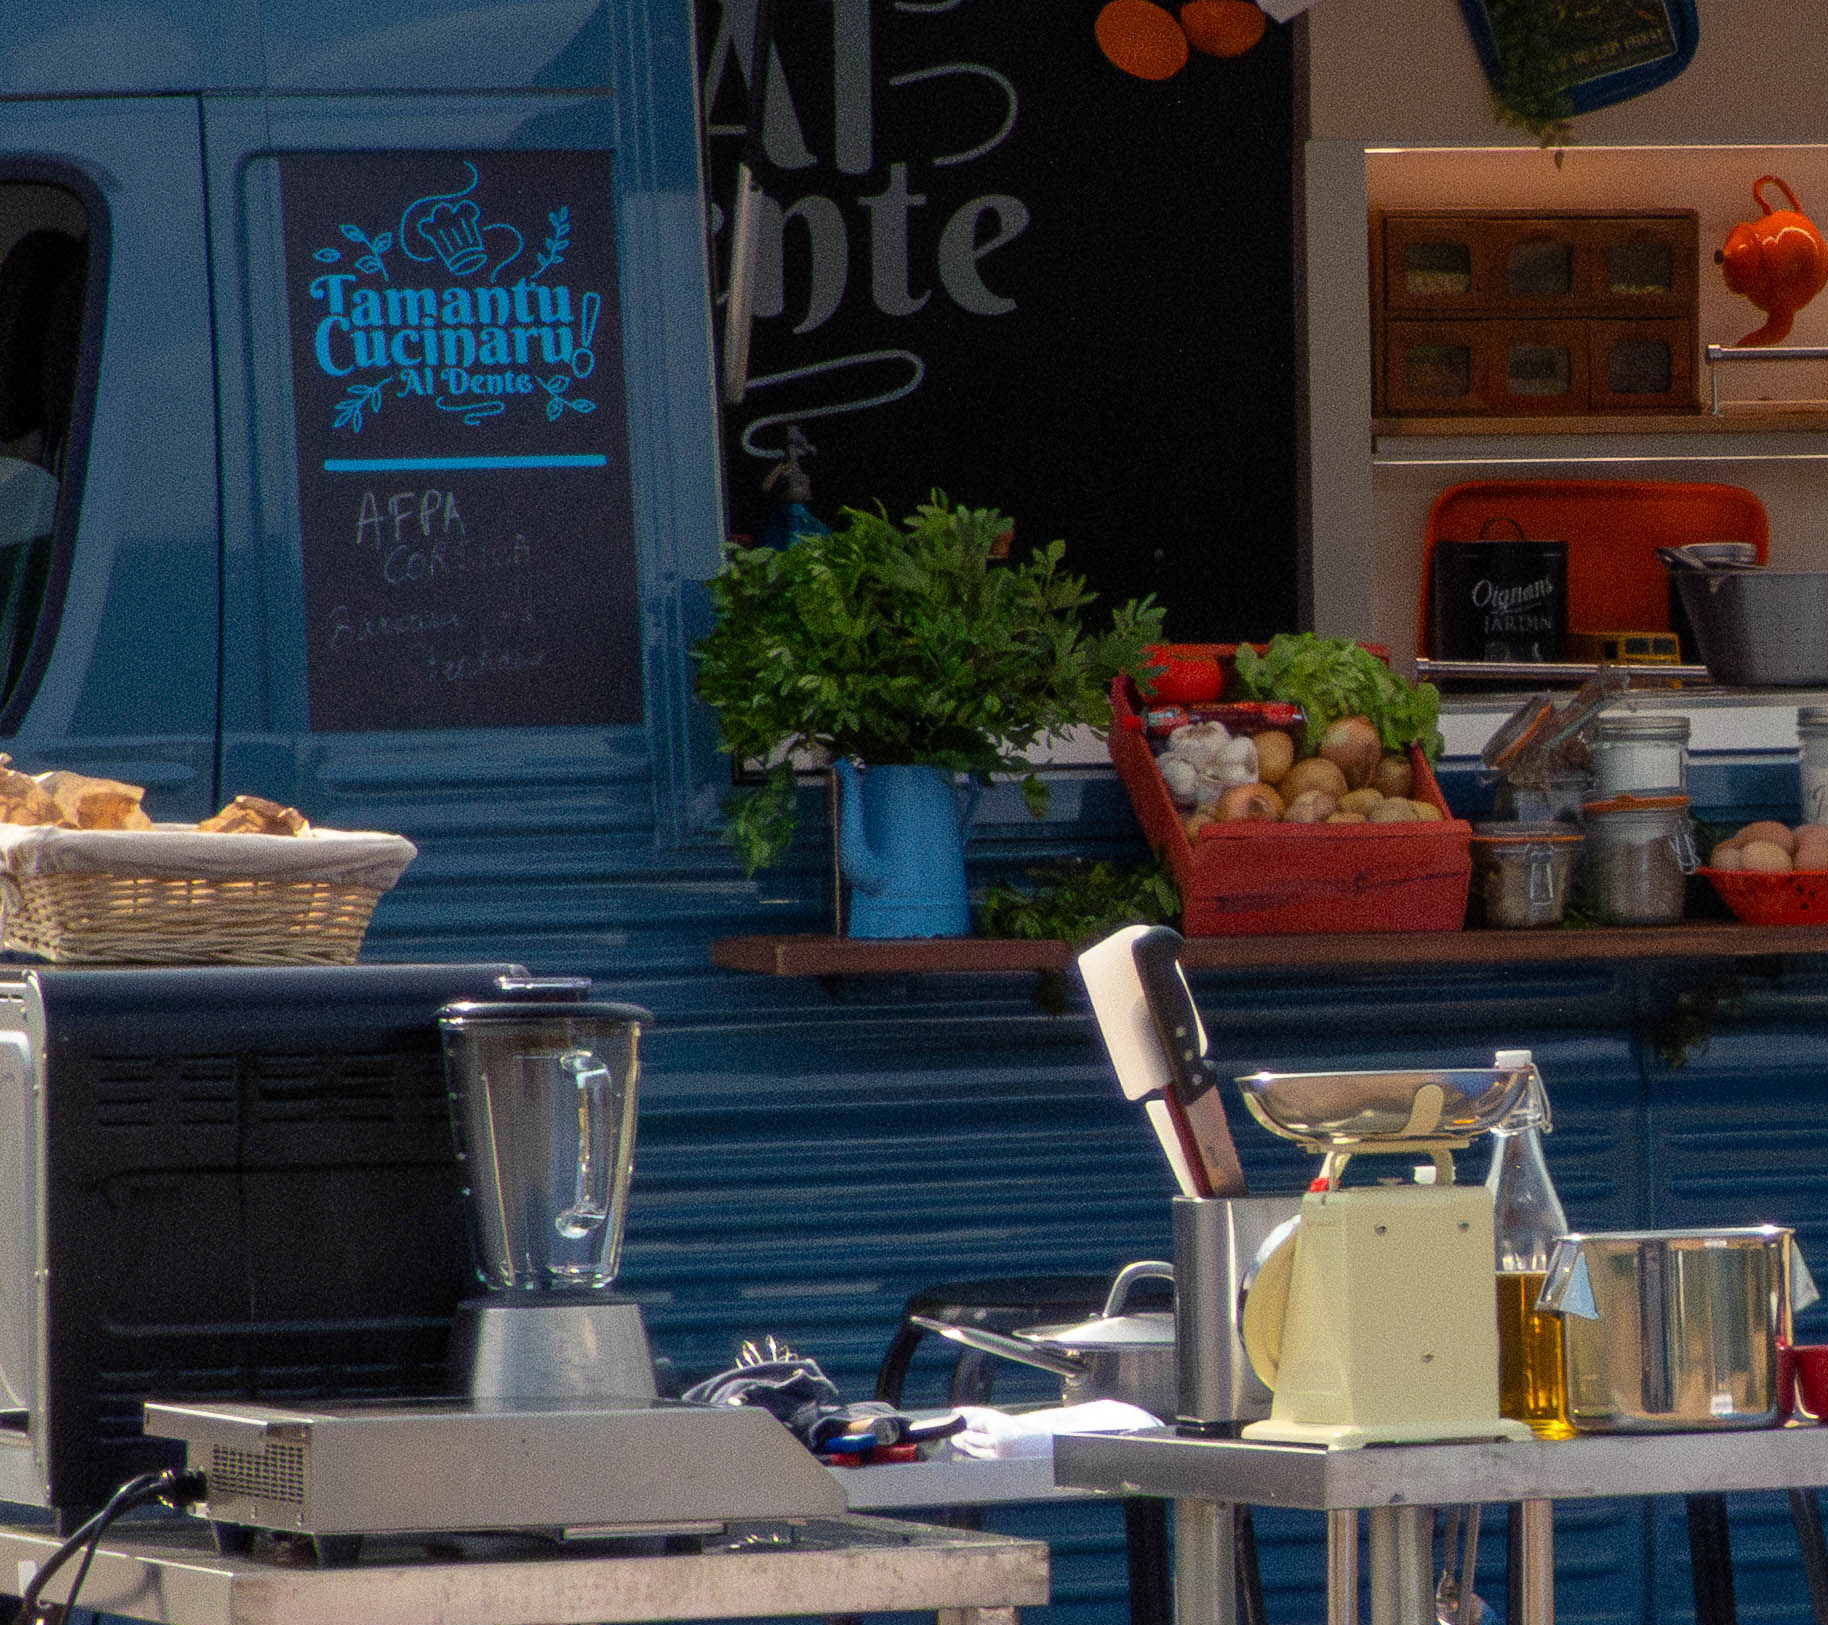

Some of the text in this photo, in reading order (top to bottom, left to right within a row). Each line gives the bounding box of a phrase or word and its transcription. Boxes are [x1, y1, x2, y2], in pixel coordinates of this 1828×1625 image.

[711, 162, 1032, 336] nte
[309, 273, 574, 329] Tamantu
[396, 365, 536, 399] Al Dente
[354, 487, 467, 551] AFPA
